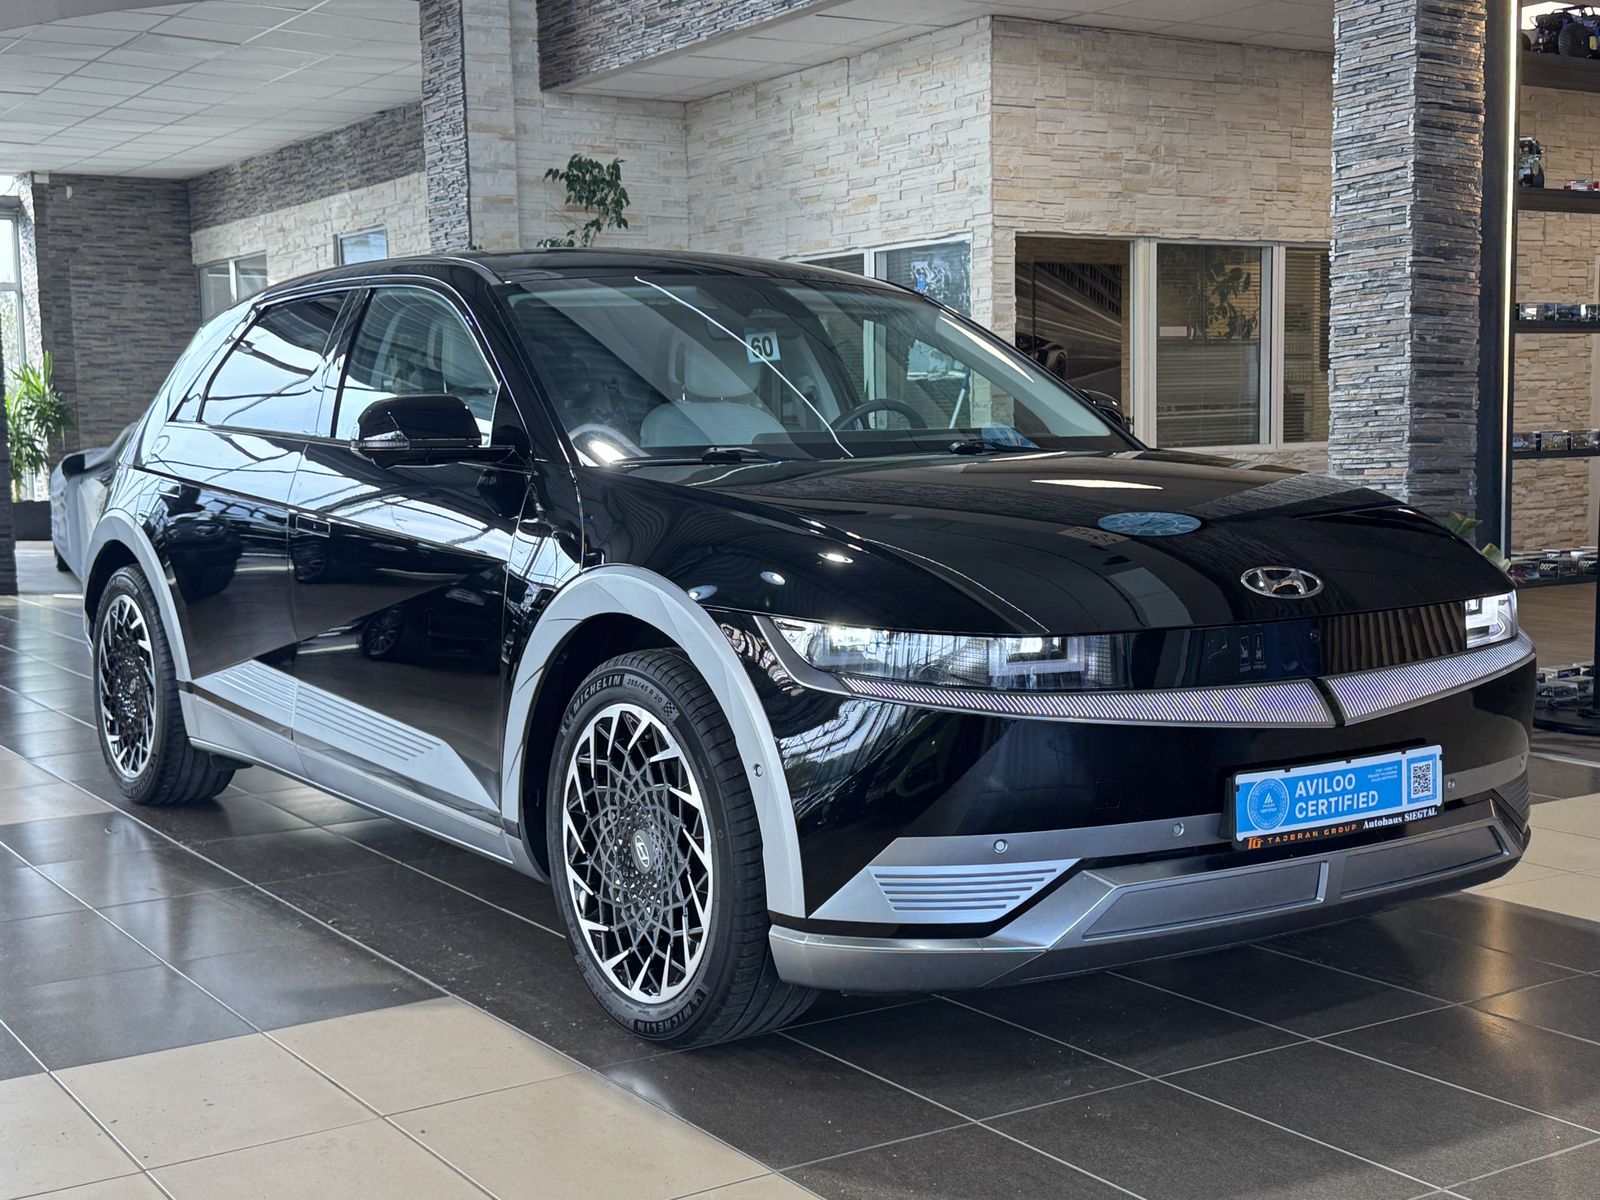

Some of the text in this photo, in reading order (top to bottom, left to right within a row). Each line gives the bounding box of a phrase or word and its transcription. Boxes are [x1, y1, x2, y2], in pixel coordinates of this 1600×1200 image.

[751, 336, 773, 358] 60
[573, 675, 622, 713] MICHELIN
[627, 679, 649, 692] 255/45
[654, 694, 663, 703] 20
[1295, 773, 1356, 798] AVILOO
[1295, 790, 1379, 819] CERTIFIED
[1324, 824, 1357, 836] GROUP
[1363, 815, 1402, 829] Autohaus
[1404, 807, 1437, 822] SIEGTAL
[637, 1005, 692, 1033] MICHELIN
